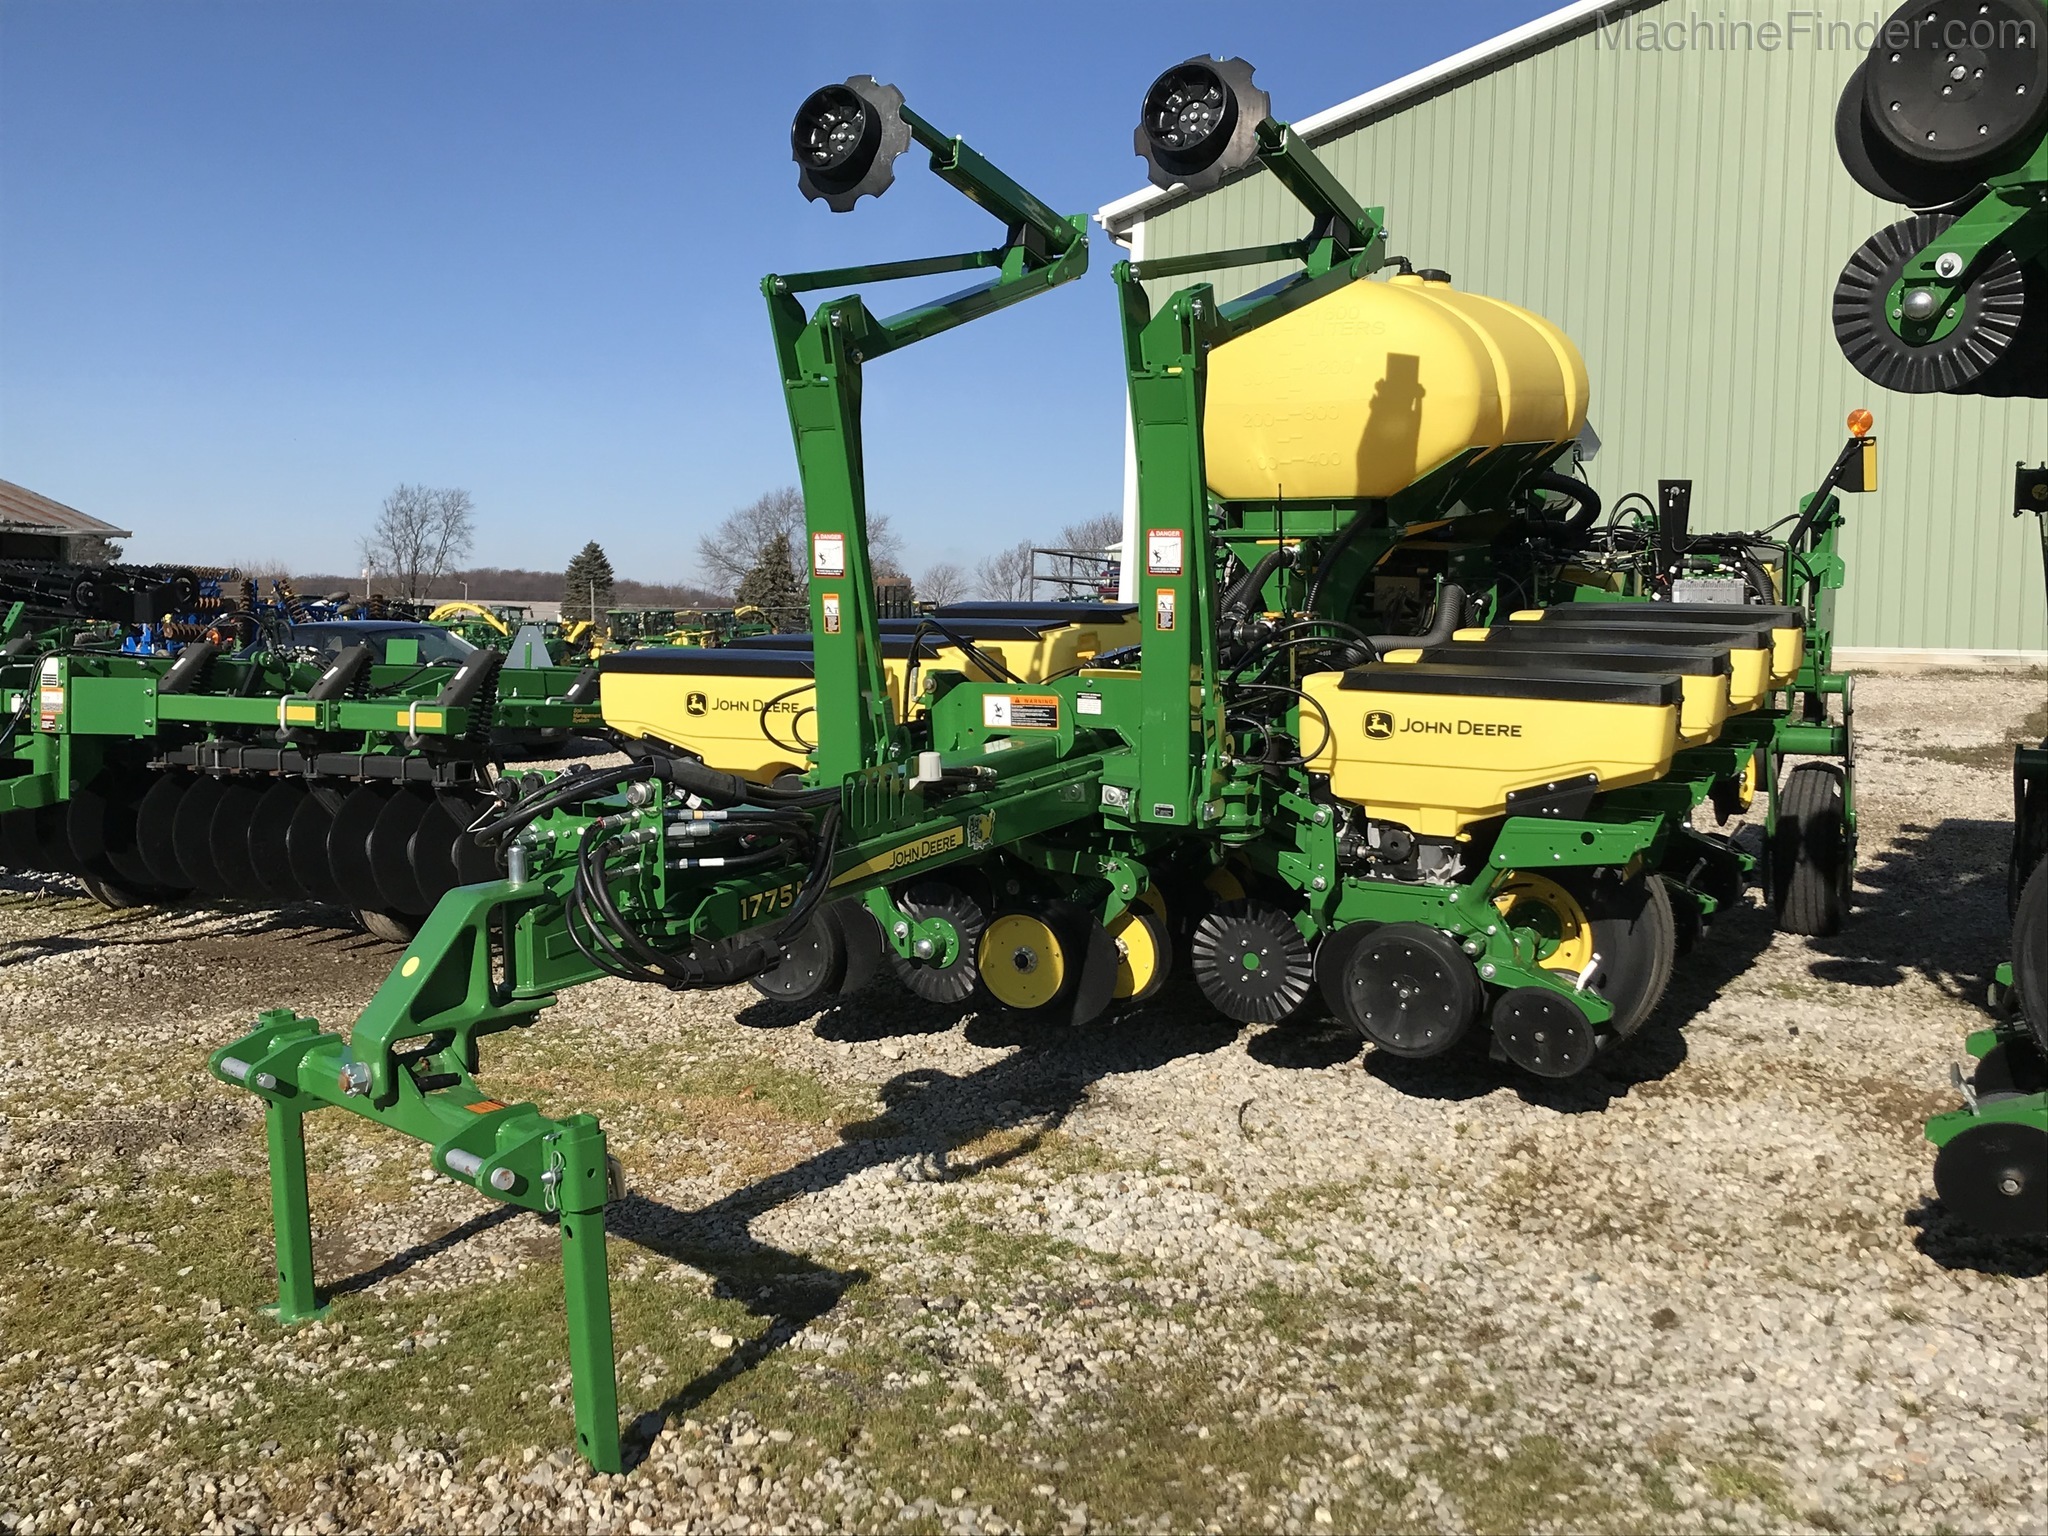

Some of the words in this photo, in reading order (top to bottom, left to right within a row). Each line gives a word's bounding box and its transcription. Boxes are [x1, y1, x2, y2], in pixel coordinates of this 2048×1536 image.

[1308, 320, 1386, 337] LITERS
[1243, 412, 1275, 428] 200
[1303, 405, 1340, 421] 800
[1306, 452, 1341, 467] 400
[711, 697, 750, 712] JOHN
[1399, 717, 1452, 735] JOHN
[1457, 719, 1523, 738] DEERE
[889, 846, 920, 868] JOHN
[921, 834, 957, 858] DEERE
